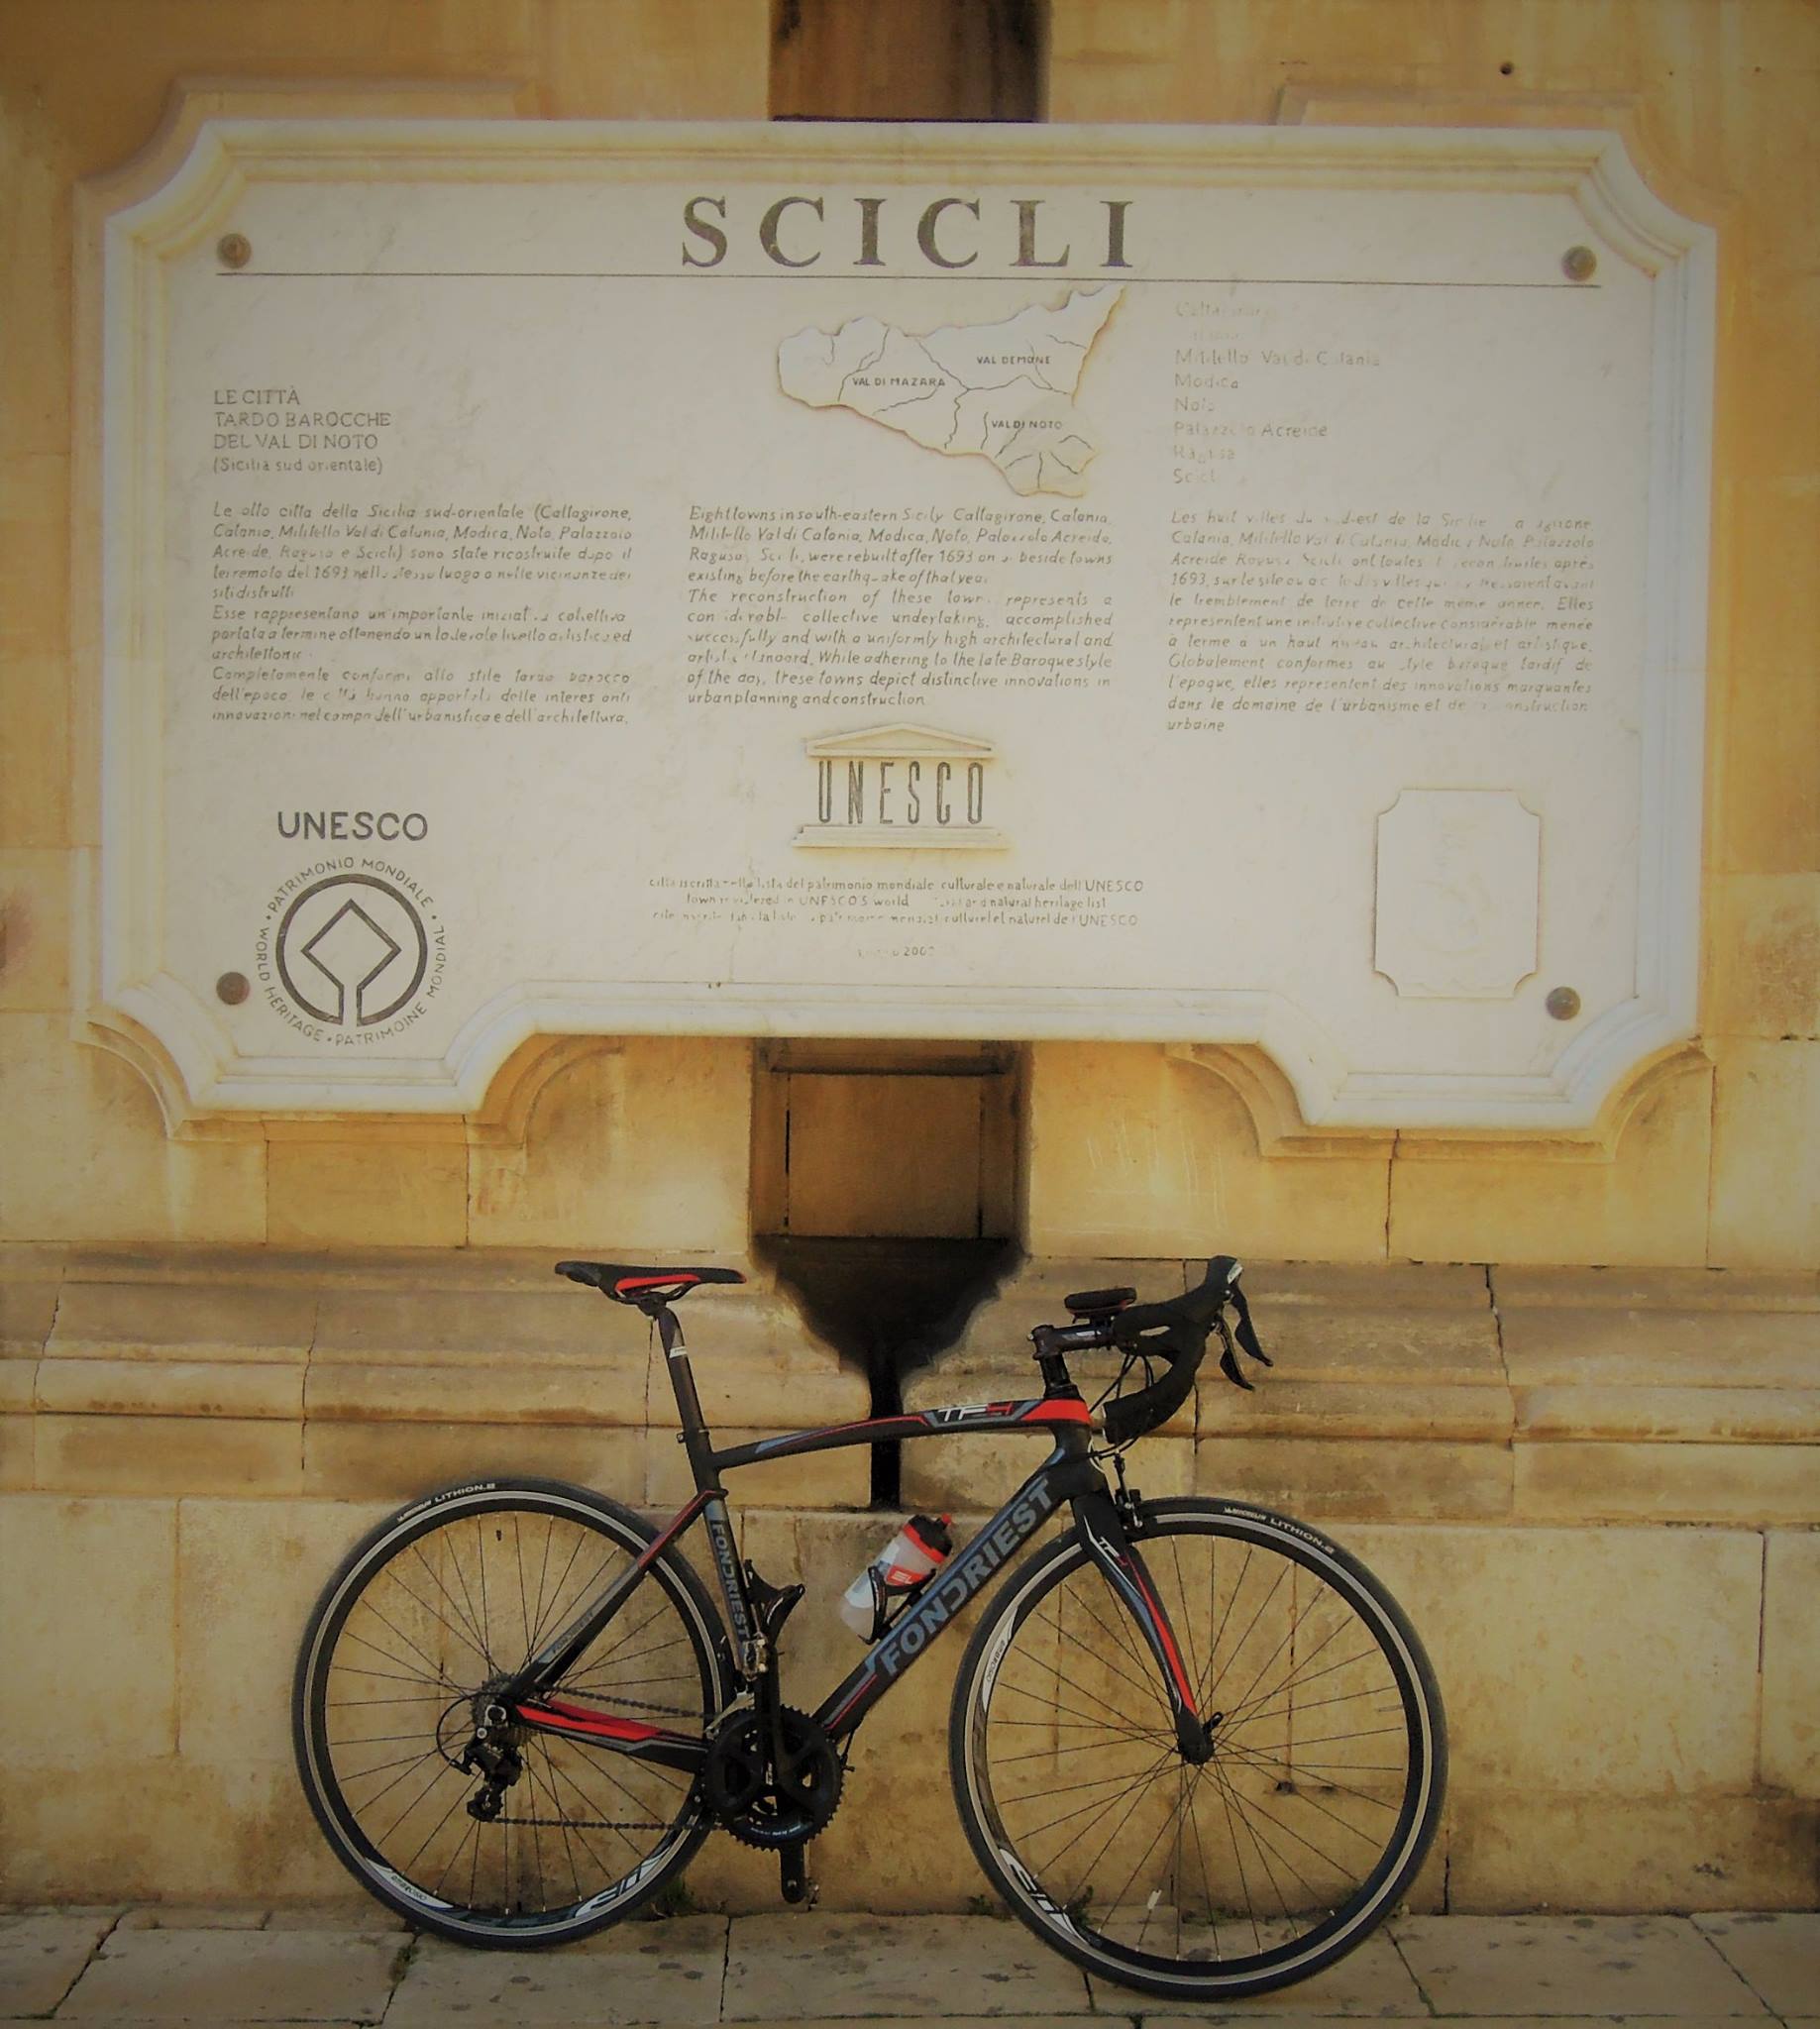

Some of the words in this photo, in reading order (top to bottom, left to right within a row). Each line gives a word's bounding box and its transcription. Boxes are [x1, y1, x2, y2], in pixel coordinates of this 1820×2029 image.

[682, 196, 1133, 268] SCICLI
[852, 377, 871, 386] VAL
[875, 377, 886, 386] DI
[891, 377, 945, 386] MAZARA
[214, 389, 237, 404] LE
[242, 384, 301, 404] CITTÀ
[215, 411, 279, 427] TARDO
[285, 411, 391, 427] BAROCCHE
[213, 434, 252, 449] DEL
[255, 434, 291, 449] VAL
[298, 434, 317, 449] DI
[323, 434, 378, 450] NOTO
[213, 457, 269, 475] (Sicilia
[276, 458, 302, 472] sud
[307, 457, 382, 476] orientale)
[213, 501, 233, 517] Le
[322, 501, 359, 518] della
[689, 505, 730, 523] Eight
[733, 506, 775, 521] towns
[780, 508, 794, 520] in
[797, 505, 897, 521] south-eastern
[758, 527, 781, 541] Val
[808, 553, 845, 562] were
[900, 548, 934, 565] after
[938, 549, 972, 564] 1693
[978, 554, 995, 563] on
[1019, 549, 1065, 564] beside
[1070, 550, 1113, 565] towns
[688, 568, 743, 585] existing
[749, 567, 795, 587] before
[798, 570, 820, 583] the
[910, 569, 926, 588] of
[689, 588, 717, 603] The
[731, 588, 847, 603] reconstruction
[862, 589, 881, 608] of
[892, 589, 932, 603] these
[212, 605, 246, 619] Esse
[803, 608, 879, 623] collective
[782, 629, 809, 644] and
[814, 629, 846, 644] with
[944, 630, 977, 649] high
[1084, 632, 1113, 647] and
[819, 648, 860, 665] While
[863, 649, 928, 669] adhering
[934, 651, 947, 666] to
[953, 651, 975, 667] the
[978, 651, 1008, 667] late
[1011, 653, 1075, 673] Baroque
[1078, 653, 1113, 671] style
[687, 668, 705, 689] of
[707, 669, 731, 684] the
[818, 670, 864, 686] towns
[871, 669, 915, 692] depict
[921, 671, 998, 688] distinctive
[1005, 673, 1089, 688] innovations
[1098, 678, 1110, 687] in
[1244, 675, 1276, 689] elles
[688, 690, 731, 704] urban
[734, 689, 799, 709] planning
[1168, 696, 1203, 711] dans
[1212, 696, 1225, 710] le
[1232, 695, 1297, 711] domaine
[1306, 697, 1323, 711] de
[1167, 717, 1226, 732] urbaine
[819, 760, 984, 824] UNESCO
[278, 810, 428, 842] UNESCO
[268, 856, 355, 913] PATRIMONIO
[362, 858, 434, 908] MONDIALE
[256, 926, 270, 981] WORLD
[264, 986, 324, 1042] HERITAGE
[336, 1001, 428, 1047] PATRIMOINE
[427, 924, 447, 1000] MONDIAL
[712, 1521, 750, 1640] FONDRIEST
[879, 1478, 1052, 1676] FONDRIEST
